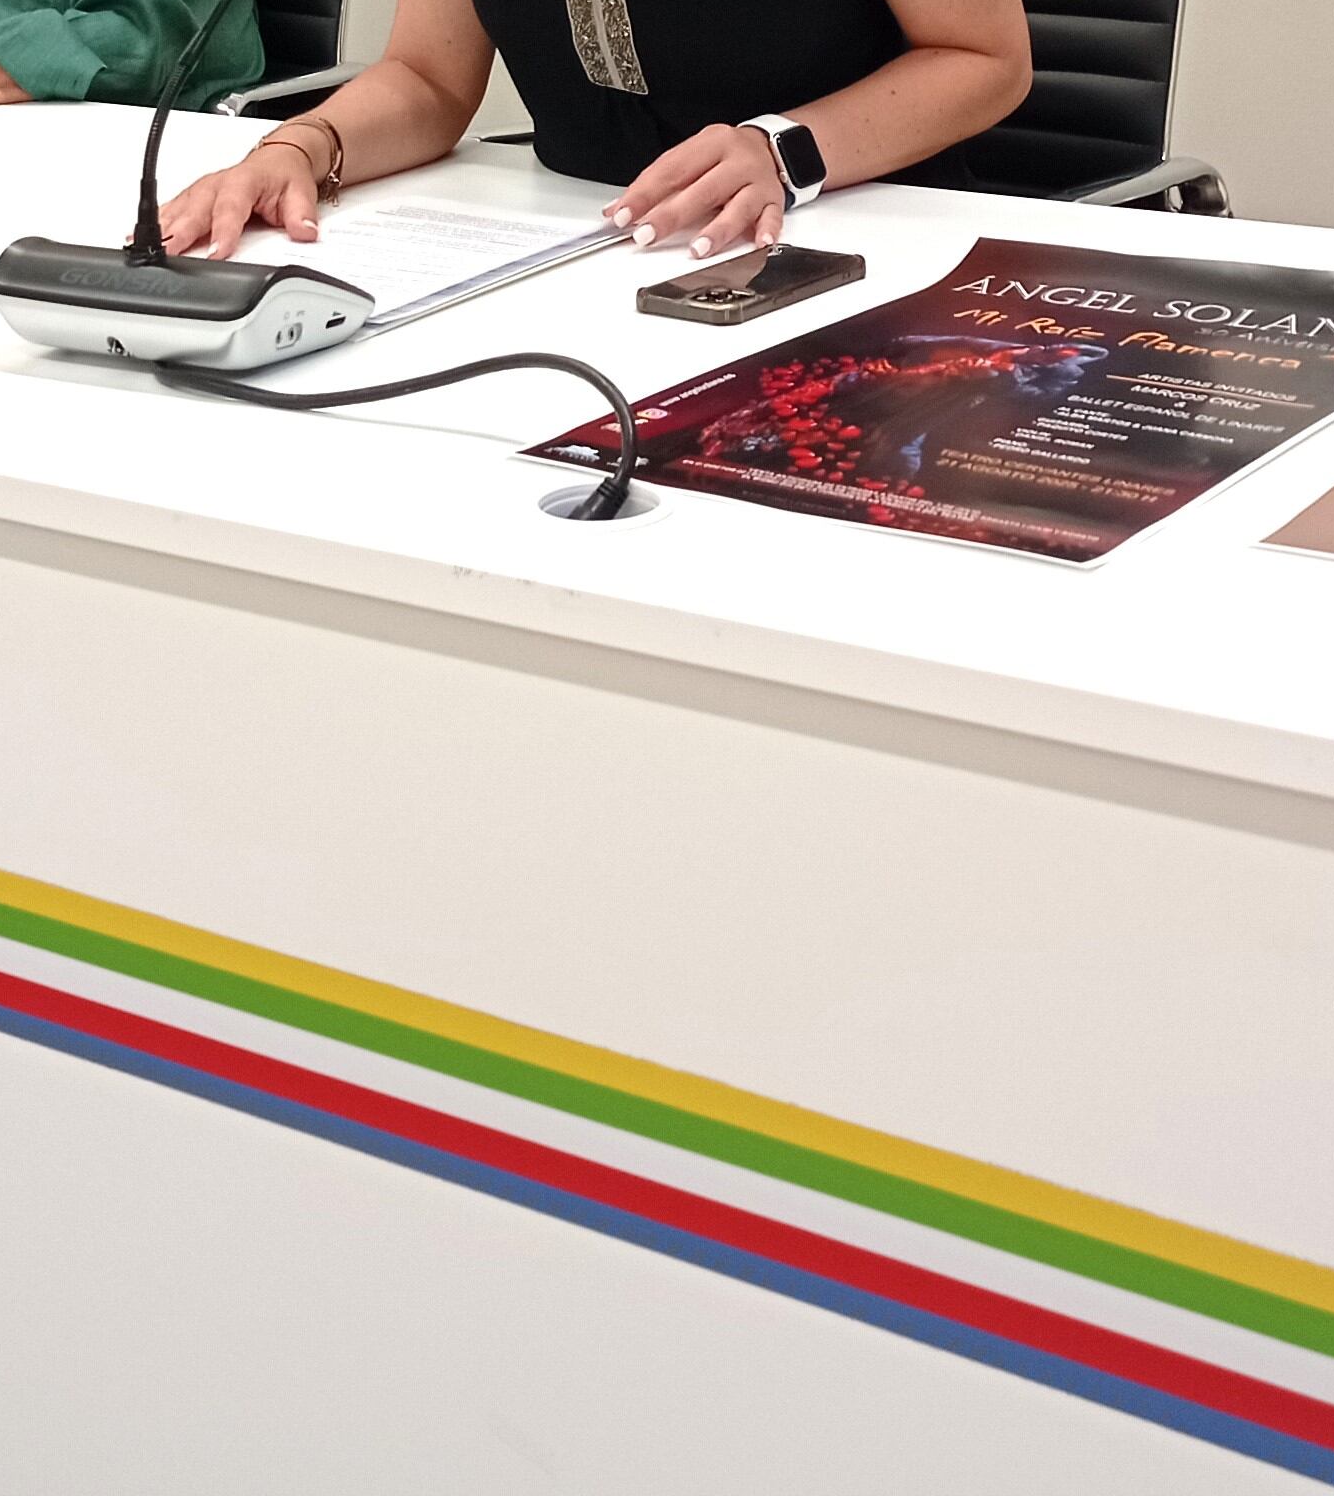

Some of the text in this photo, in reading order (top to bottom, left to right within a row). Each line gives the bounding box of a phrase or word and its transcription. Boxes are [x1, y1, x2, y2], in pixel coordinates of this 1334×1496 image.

[953, 275, 1139, 315] ÁNGEL
[953, 307, 1008, 326] Mi
[1118, 332, 1303, 370] Flamenca
[1067, 394, 1124, 407] BALLET
[1130, 384, 1262, 411] MARCOS CRUZ
[1138, 373, 1297, 401] ARTISTAS INVITADOS
